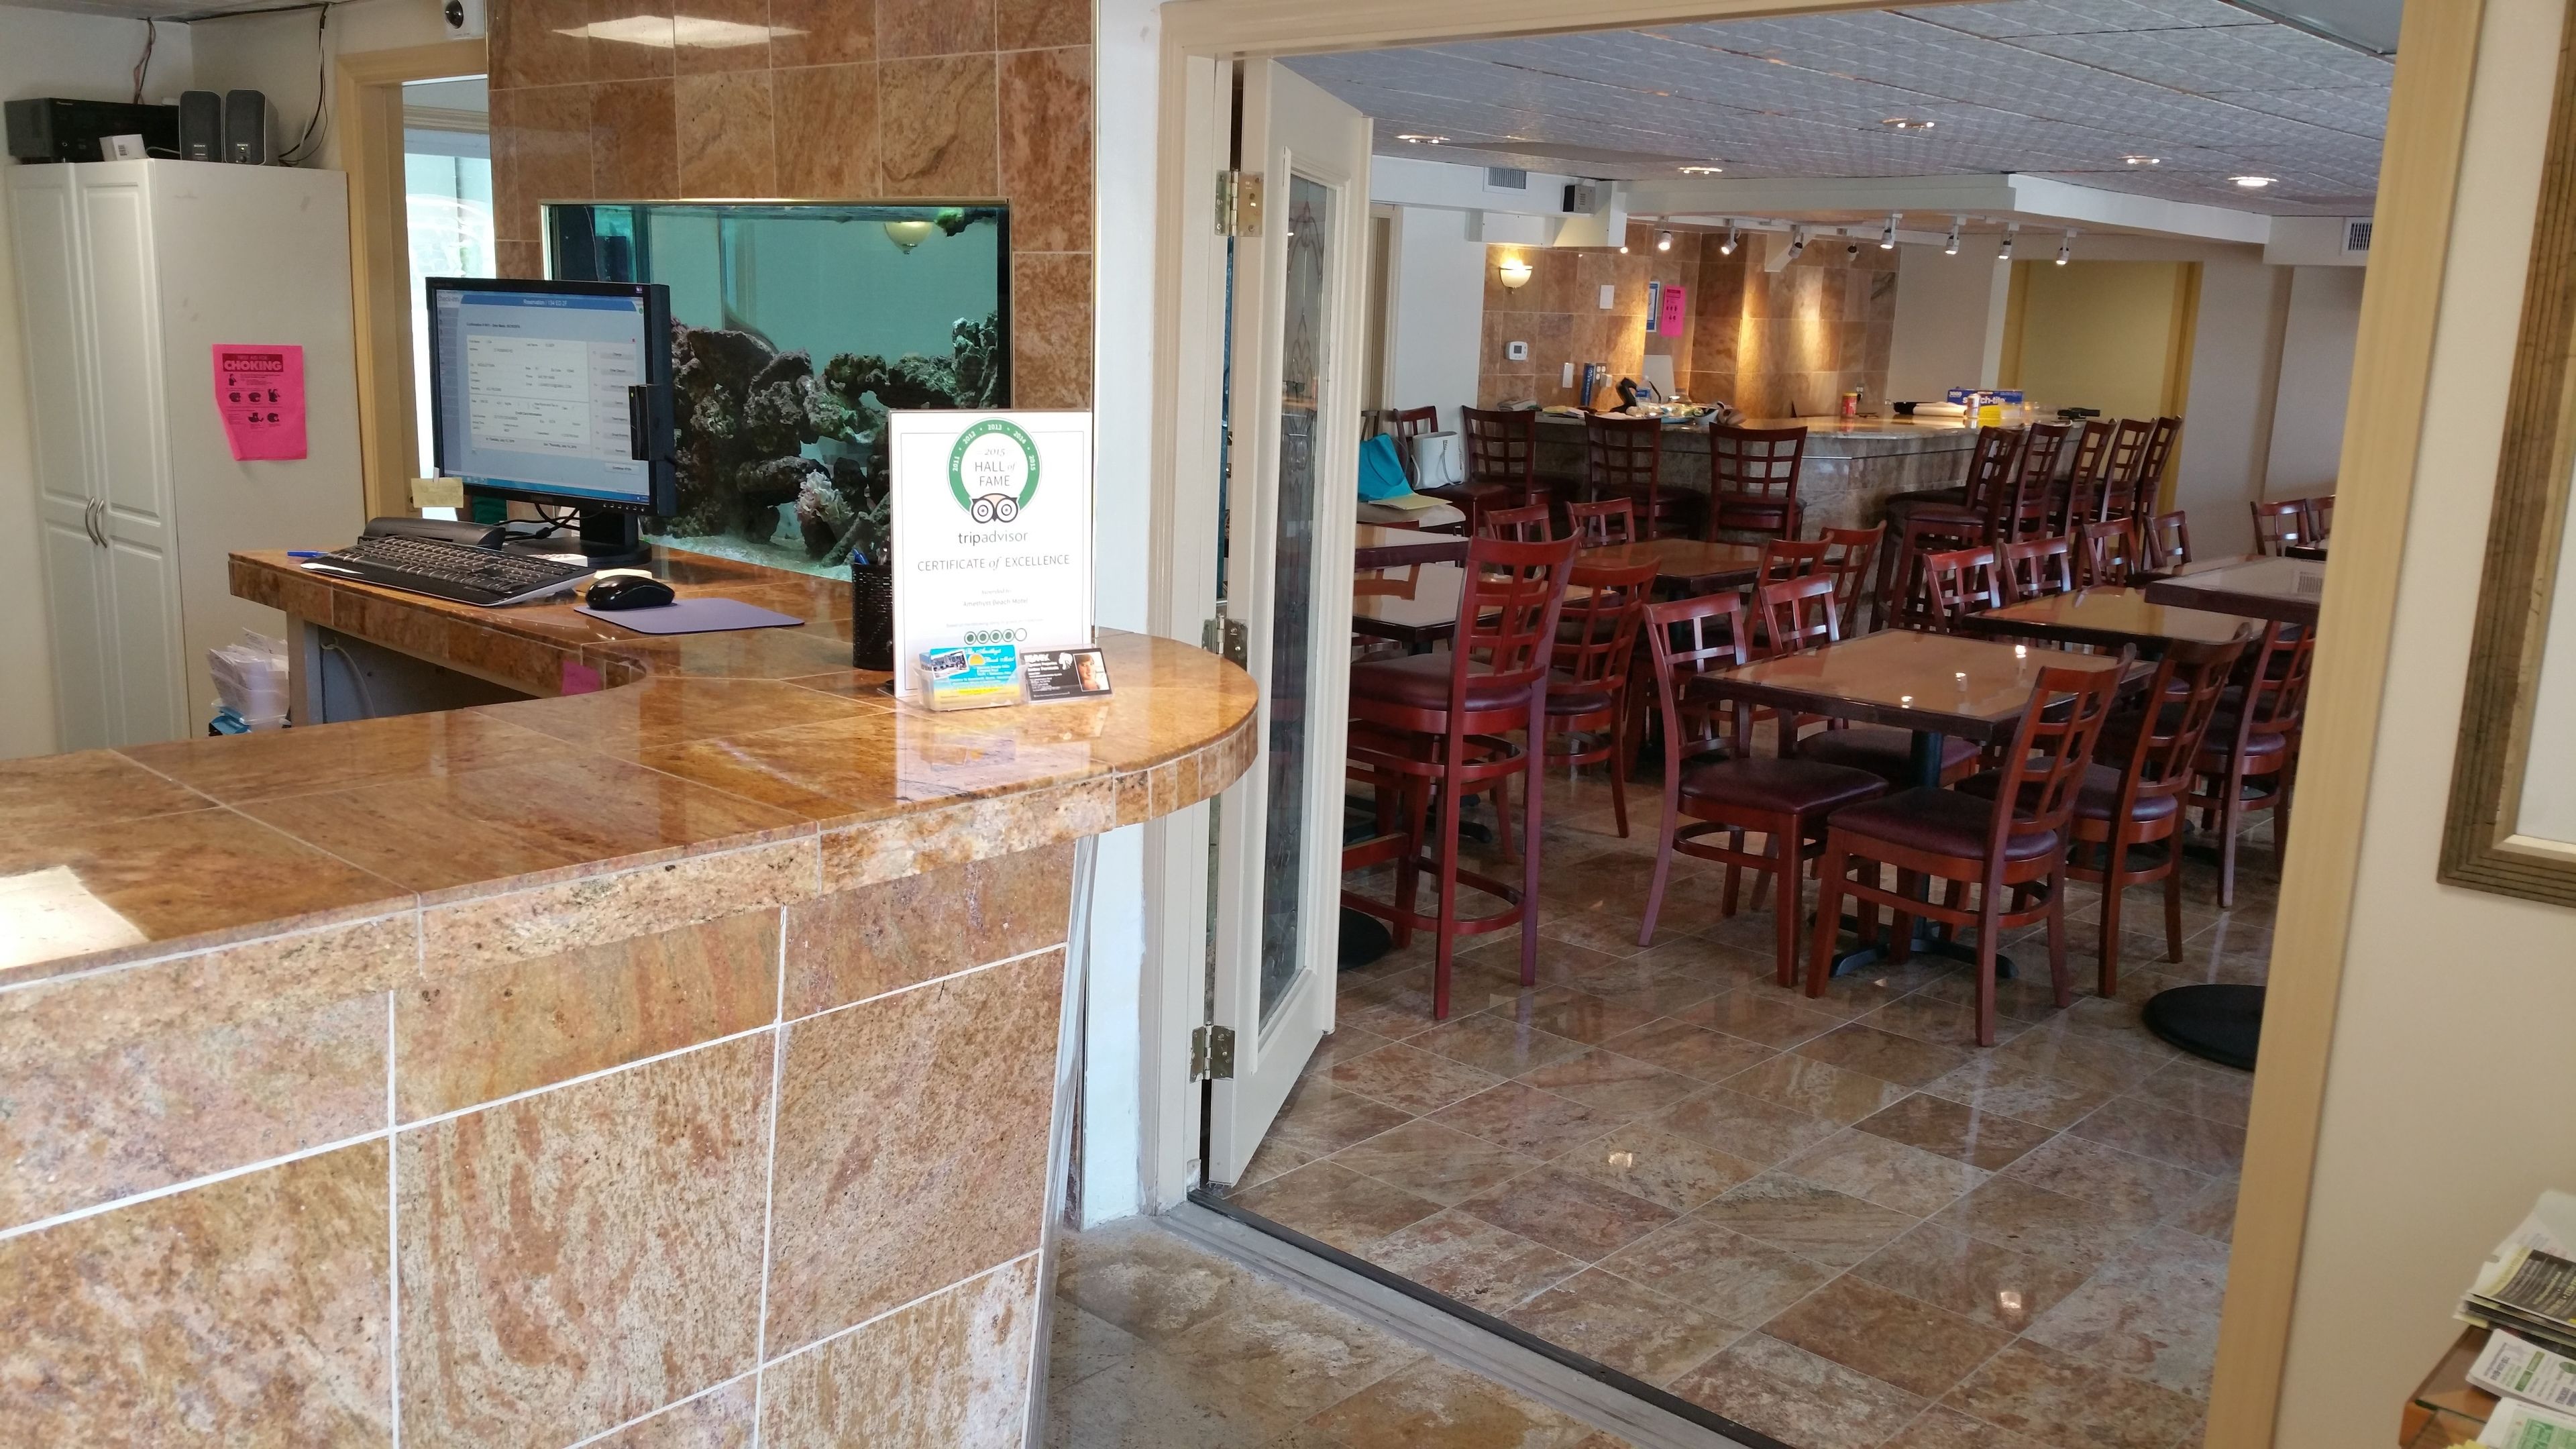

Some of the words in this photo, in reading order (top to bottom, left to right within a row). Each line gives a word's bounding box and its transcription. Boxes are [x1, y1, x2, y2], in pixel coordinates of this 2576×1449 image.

[224, 360, 282, 370] CHOKING
[963, 431, 976, 444] 2012
[1013, 431, 1026, 444] 2014
[984, 448, 1005, 457] 2015
[975, 462, 1005, 472] HALL
[1007, 463, 1016, 472] of
[1028, 455, 1036, 471] 2015
[979, 475, 1010, 486] FAME
[958, 530, 1028, 546] tripadvisor
[918, 559, 985, 572] CERTIFICATE
[989, 556, 1003, 571] of
[1006, 554, 1070, 568] EXCELLENCE
